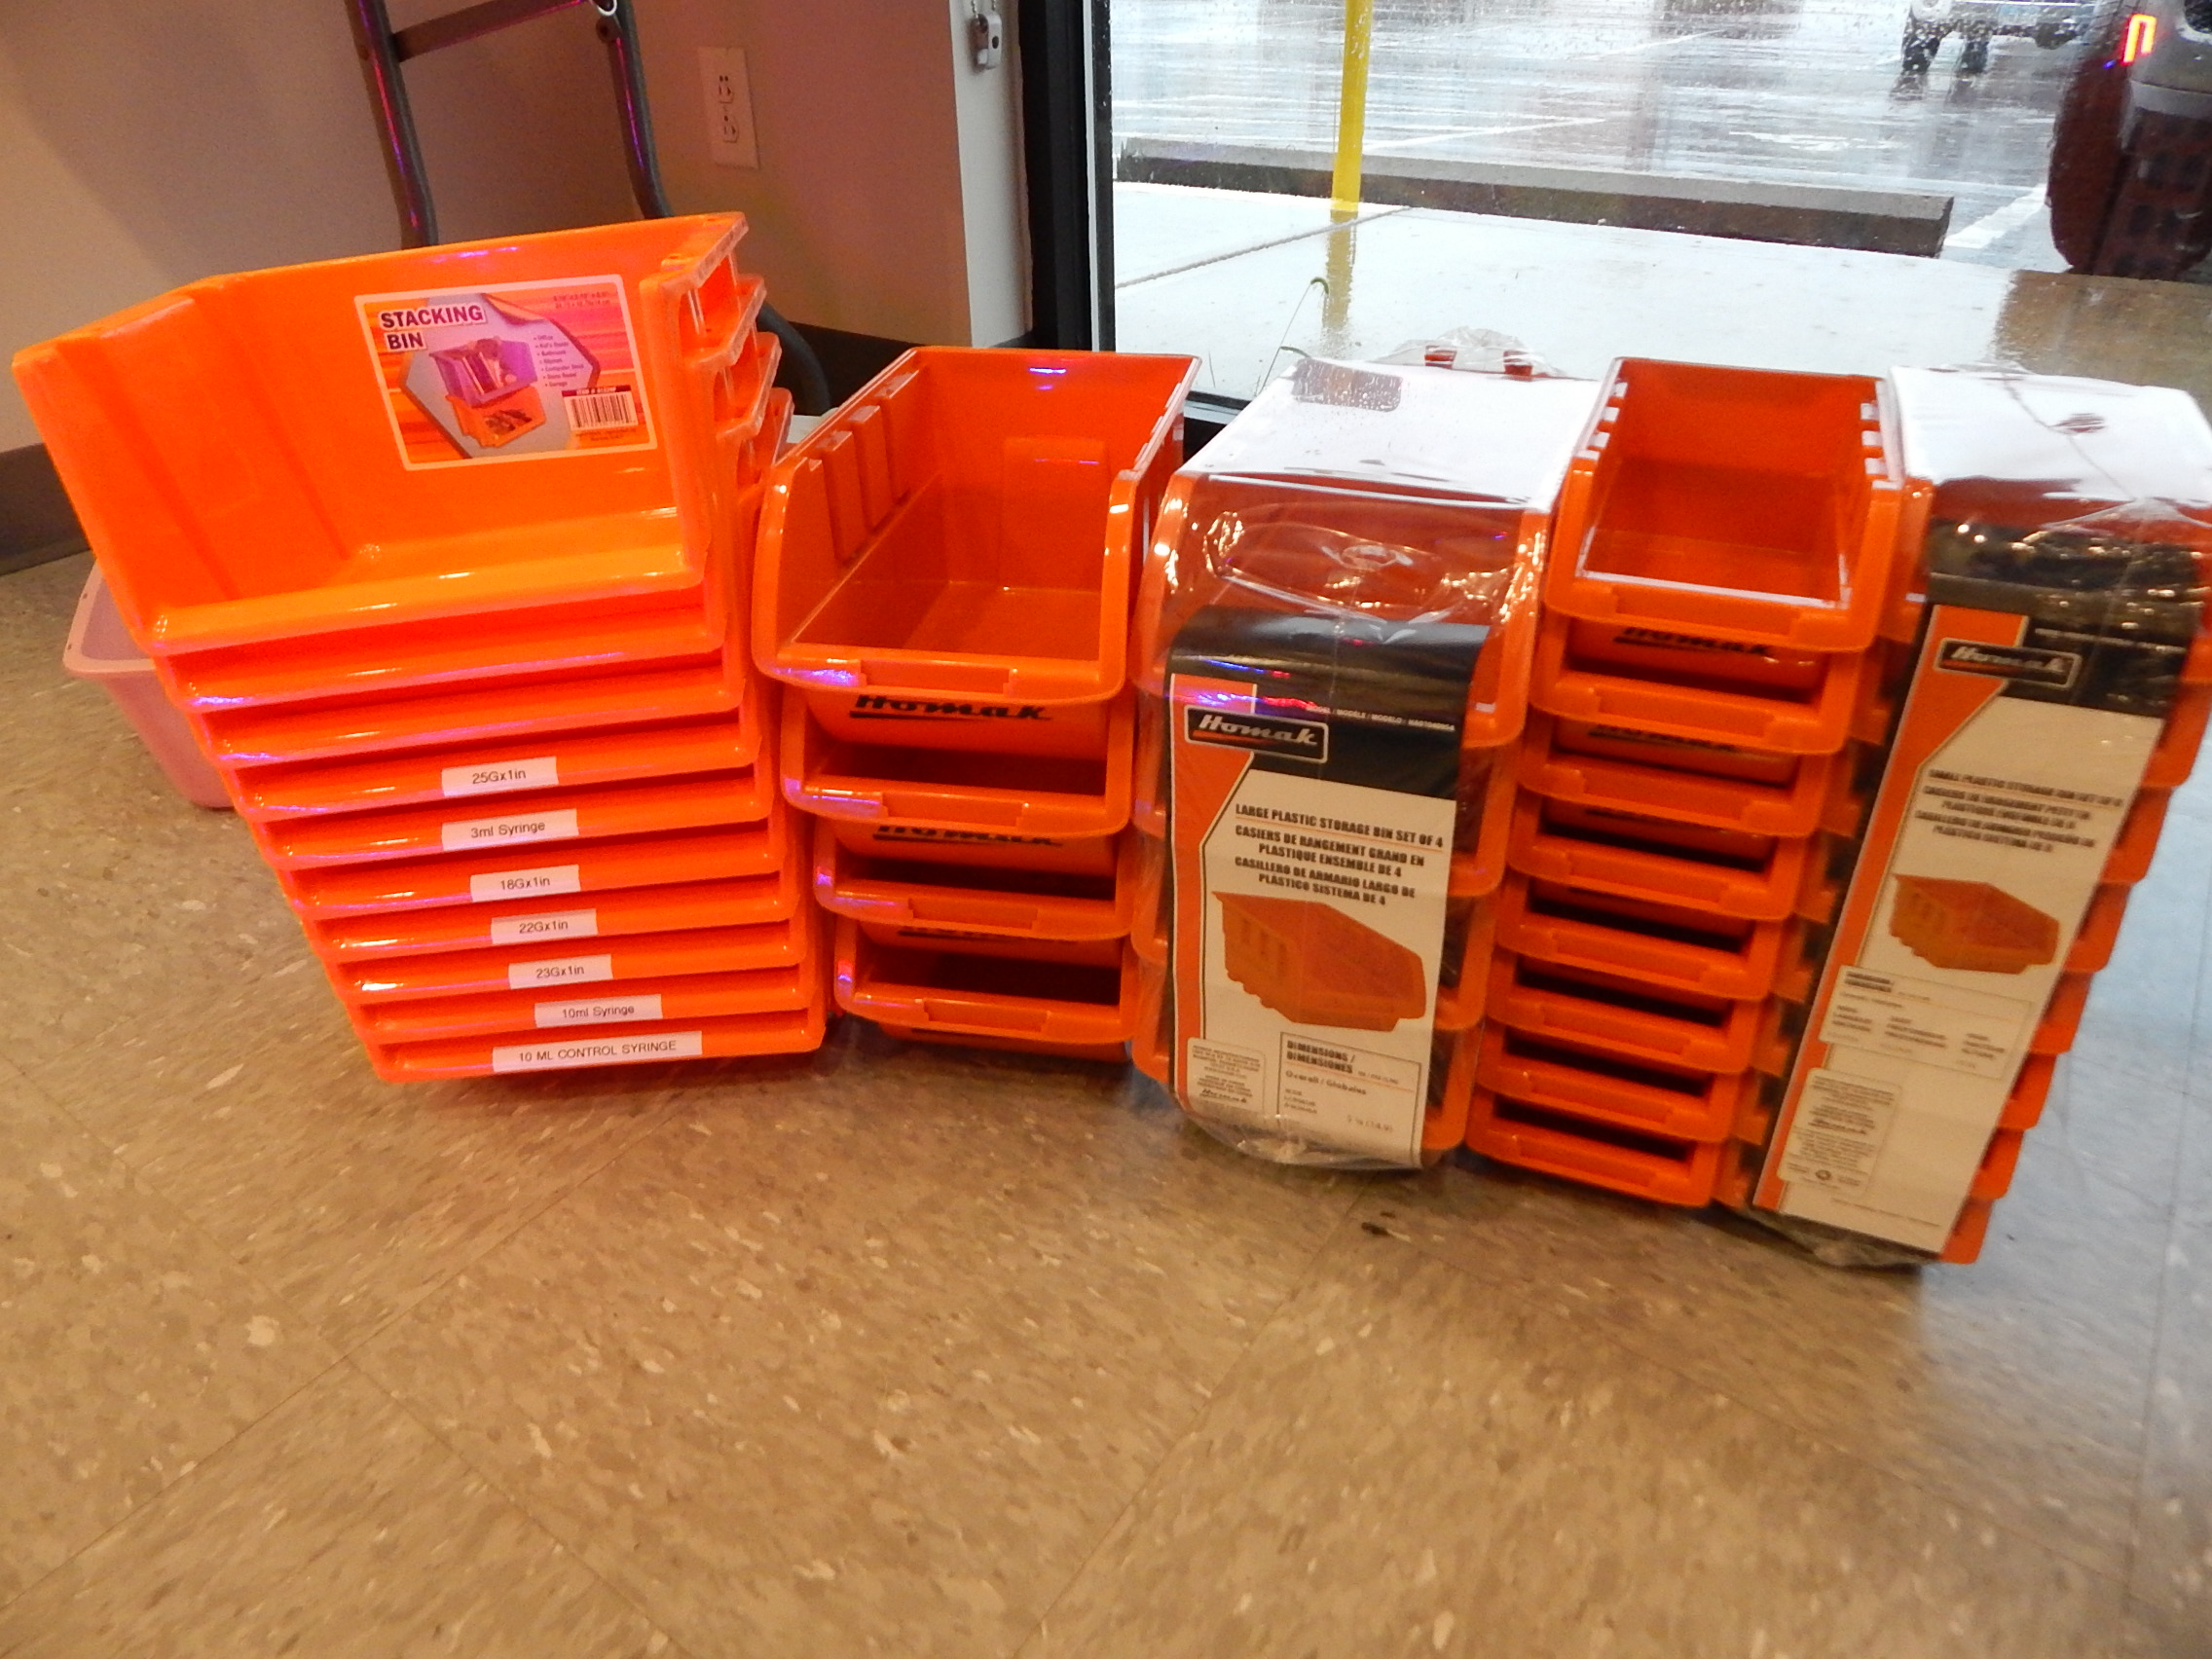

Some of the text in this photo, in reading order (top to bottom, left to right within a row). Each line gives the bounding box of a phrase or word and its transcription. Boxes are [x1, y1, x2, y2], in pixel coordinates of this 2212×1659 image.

[382, 305, 484, 328] STACKING
[387, 331, 424, 350] BIN
[1951, 645, 2065, 675] Homak
[856, 694, 1051, 720] Homak
[1198, 714, 1318, 746] Homak
[472, 769, 527, 785] 25Gx1in
[471, 822, 545, 838] 3ml Syringe
[1235, 803, 1443, 848] LARGE PLASTIC STORAGE BIN SET OF 4
[1235, 825, 1424, 866] CASIERS DE RANGEMENT GRAND EN
[1259, 843, 1402, 877] PLASTIQUE ENSEMBLE DE 4
[500, 876, 550, 890] 18Gx1in
[1235, 856, 1416, 898] CASILLERO DE ARMARIO LARGO DE
[1312, 882, 1360, 901] SISTEMA
[1363, 892, 1376, 903] DE
[1380, 896, 1385, 905] 4
[519, 920, 569, 934] 22Gx1in
[536, 966, 585, 978] 23Gx1in
[563, 1005, 635, 1018] 10ml Syringe
[520, 1040, 677, 1062] 10 ML CONTROL SYRINGE
[1287, 1040, 1348, 1062] DIMENSIONS
[1287, 1051, 1353, 1074] DIMENSIONES
